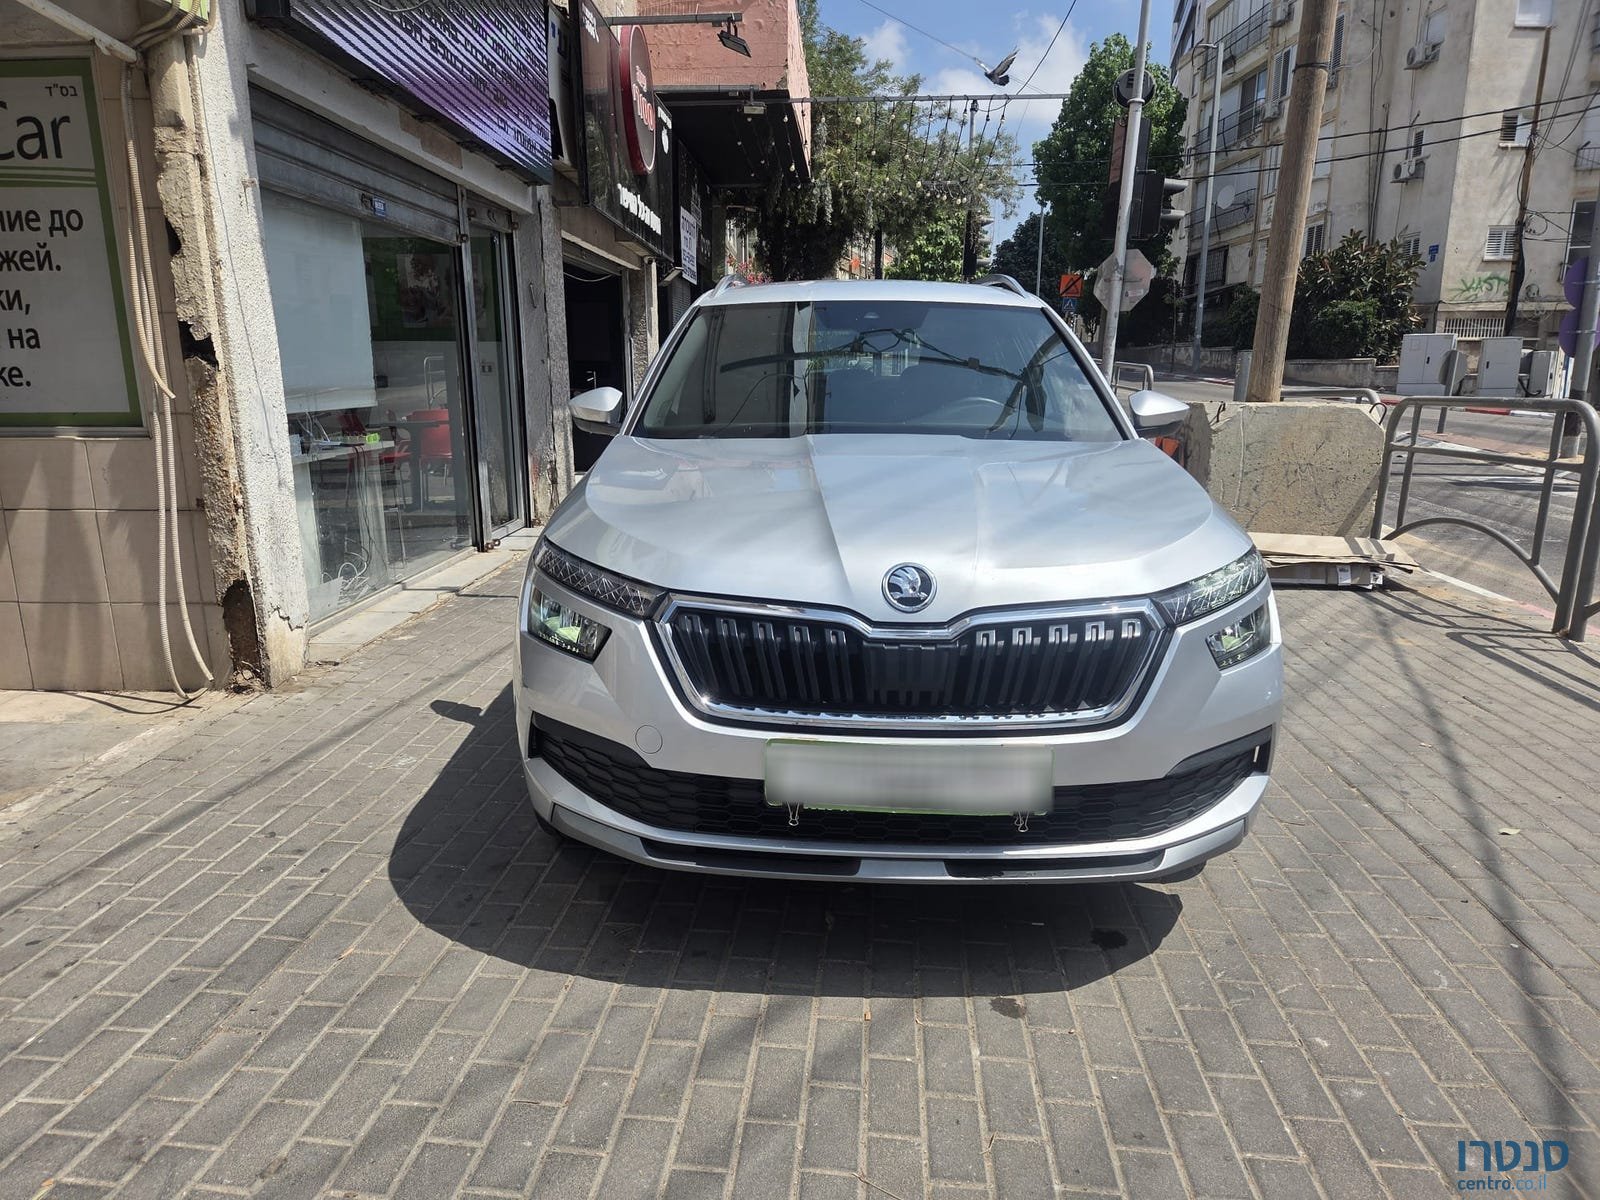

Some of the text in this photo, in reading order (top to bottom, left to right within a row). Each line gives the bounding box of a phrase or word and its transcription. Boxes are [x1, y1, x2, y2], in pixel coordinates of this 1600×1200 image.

[45, 83, 78, 97] בס"ד
[48, 209, 84, 238] до
[7, 327, 41, 349] на
